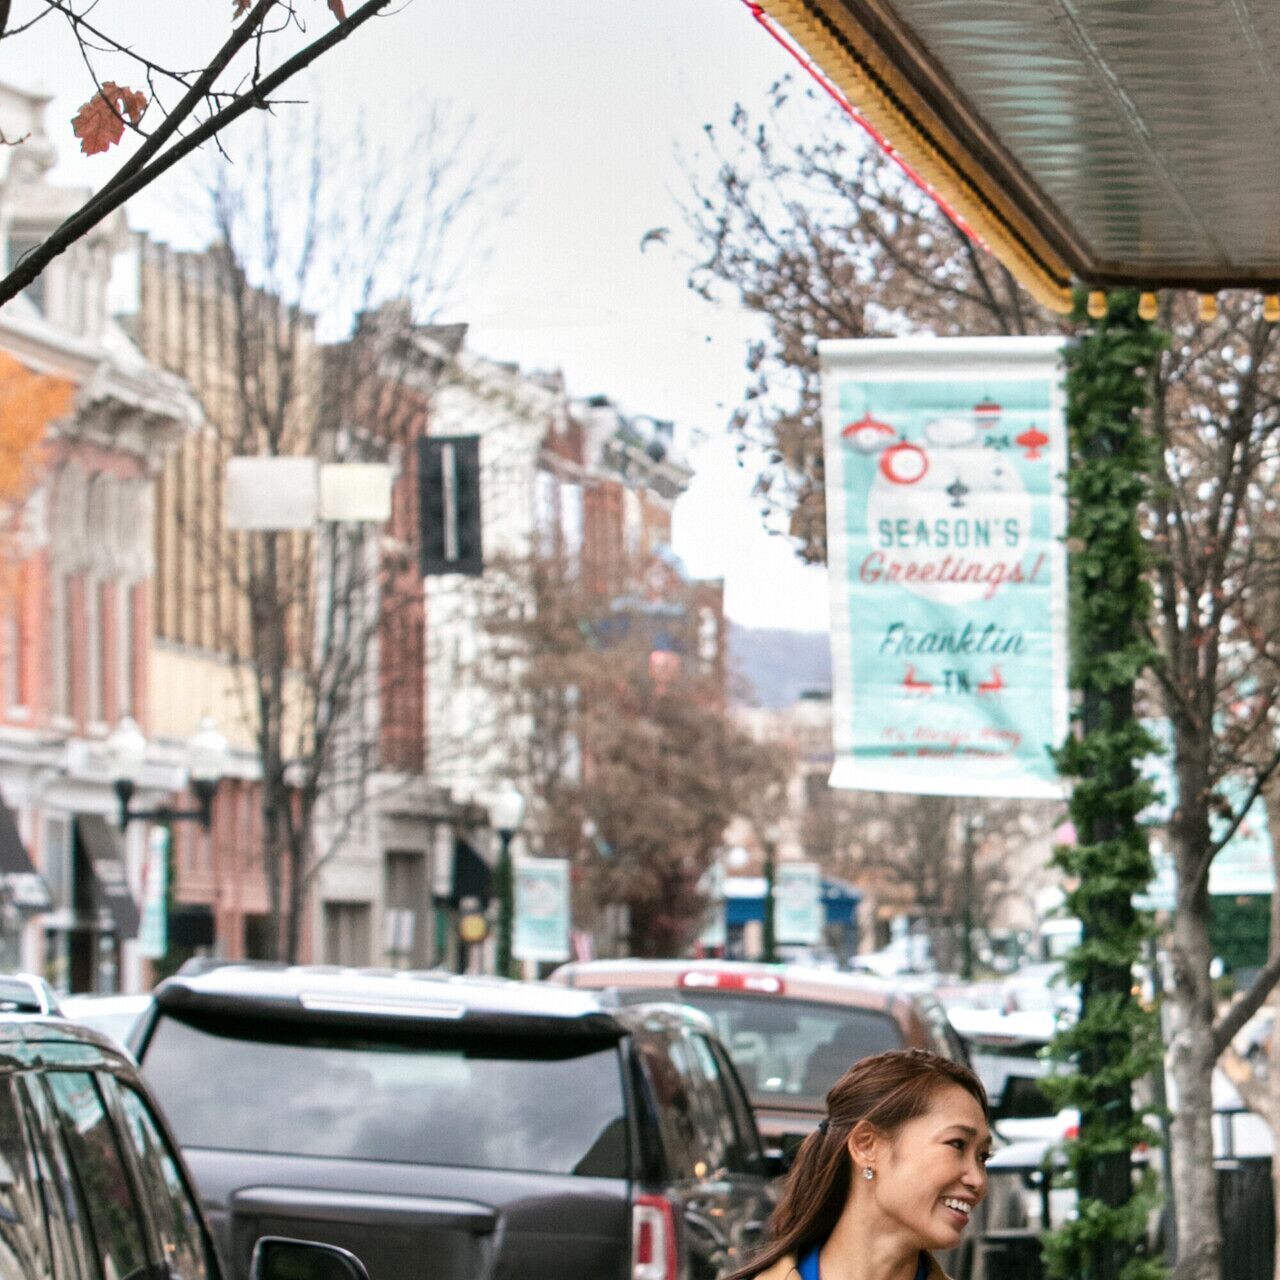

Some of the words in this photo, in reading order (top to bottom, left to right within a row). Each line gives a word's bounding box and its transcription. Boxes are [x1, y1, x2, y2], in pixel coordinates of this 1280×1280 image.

[878, 518, 1020, 548] SEASON'S
[859, 551, 1046, 599] Greetings!
[877, 621, 1027, 656] Franklin
[942, 669, 972, 695] TN
